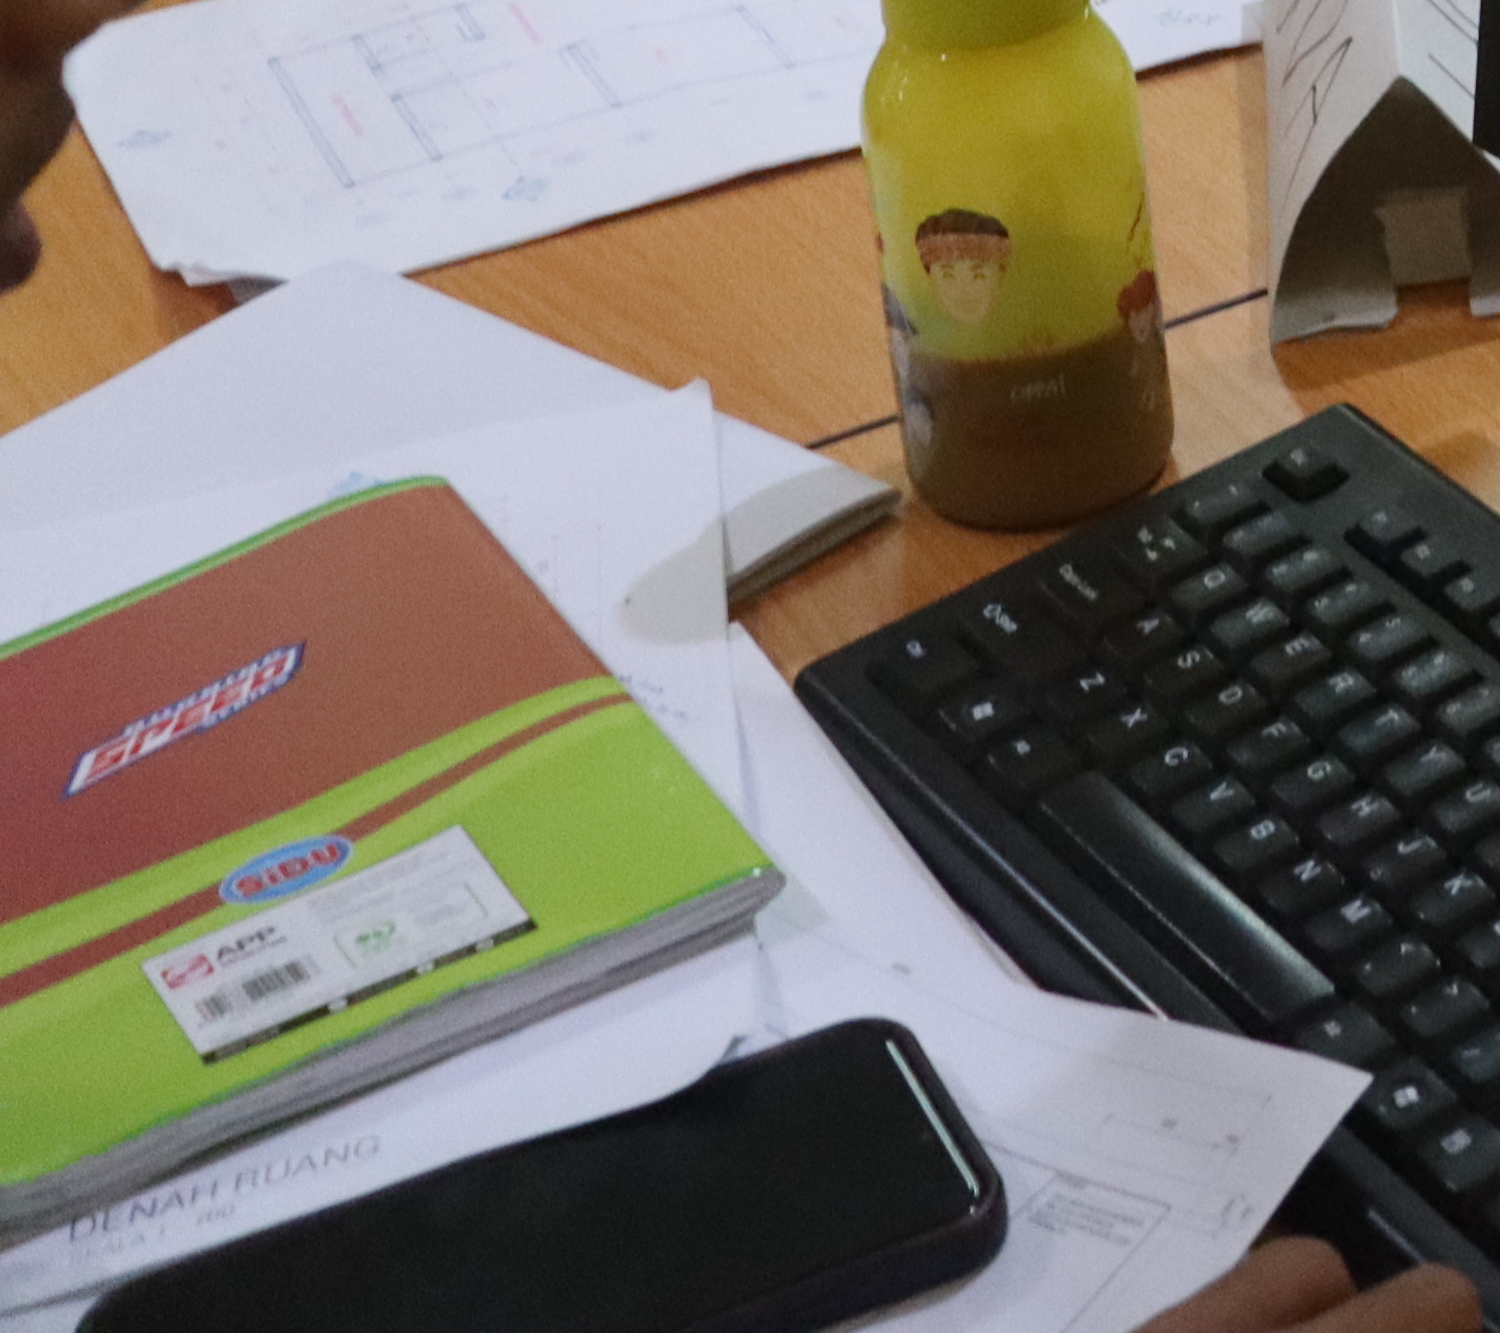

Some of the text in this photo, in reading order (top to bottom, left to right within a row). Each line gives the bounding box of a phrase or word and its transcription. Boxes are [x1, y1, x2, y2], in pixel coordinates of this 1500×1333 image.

[1176, 651, 1202, 671] S
[84, 653, 290, 783] SPEED
[1120, 707, 1149, 729] X
[1163, 745, 1190, 768] C
[1306, 758, 1334, 781] G
[1208, 781, 1237, 803] V
[1464, 781, 1492, 803] U
[1349, 795, 1381, 819] H
[1250, 818, 1277, 841] B
[1293, 858, 1323, 883] N
[1443, 872, 1472, 896] K
[1339, 897, 1373, 924] M
[215, 925, 276, 961] APP
